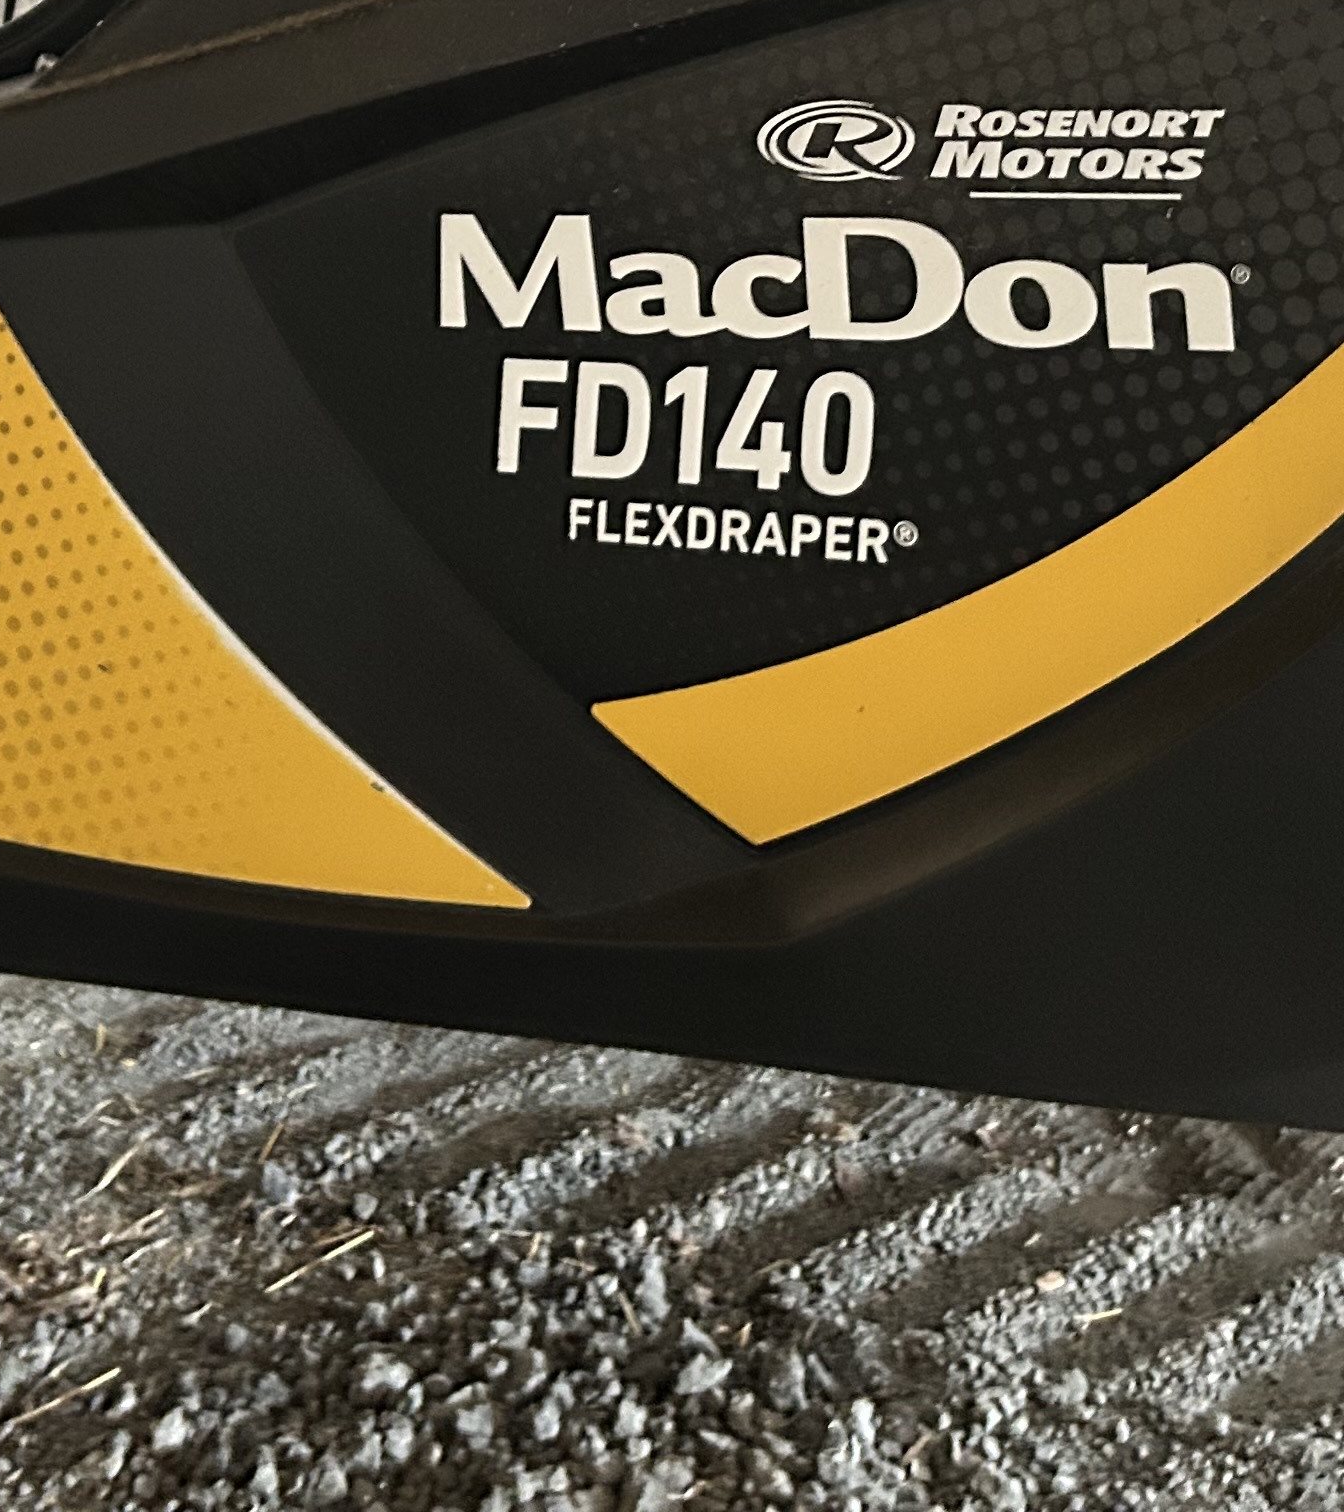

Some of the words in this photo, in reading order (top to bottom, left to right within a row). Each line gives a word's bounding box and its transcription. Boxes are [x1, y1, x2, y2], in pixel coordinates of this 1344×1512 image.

[934, 104, 1226, 138] ROSENORT
[929, 140, 1206, 181] MOTORS
[496, 357, 875, 497] FD140
